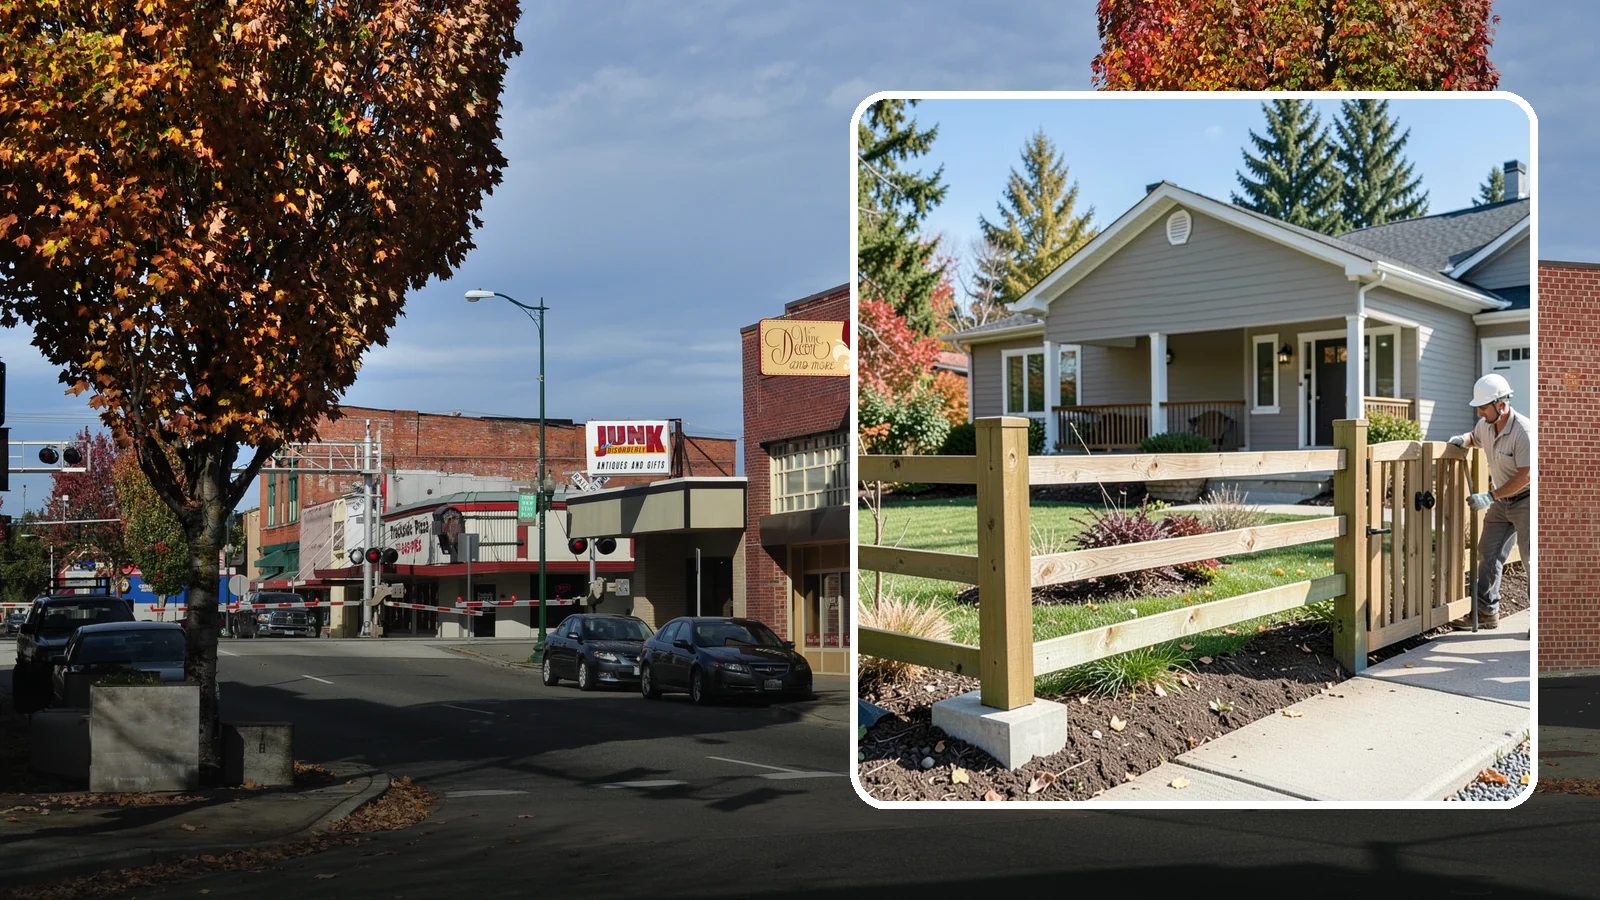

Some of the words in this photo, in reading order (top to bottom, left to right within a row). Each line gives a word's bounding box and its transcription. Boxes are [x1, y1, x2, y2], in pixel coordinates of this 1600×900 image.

[596, 426, 664, 457] JUNK
[607, 446, 646, 454] DISORDERLY
[597, 461, 628, 470] ANTIQUES
[631, 461, 644, 470] AND
[647, 460, 665, 469] GIFTS
[390, 522, 412, 539] Trackside
[414, 520, 429, 534] Pizza
